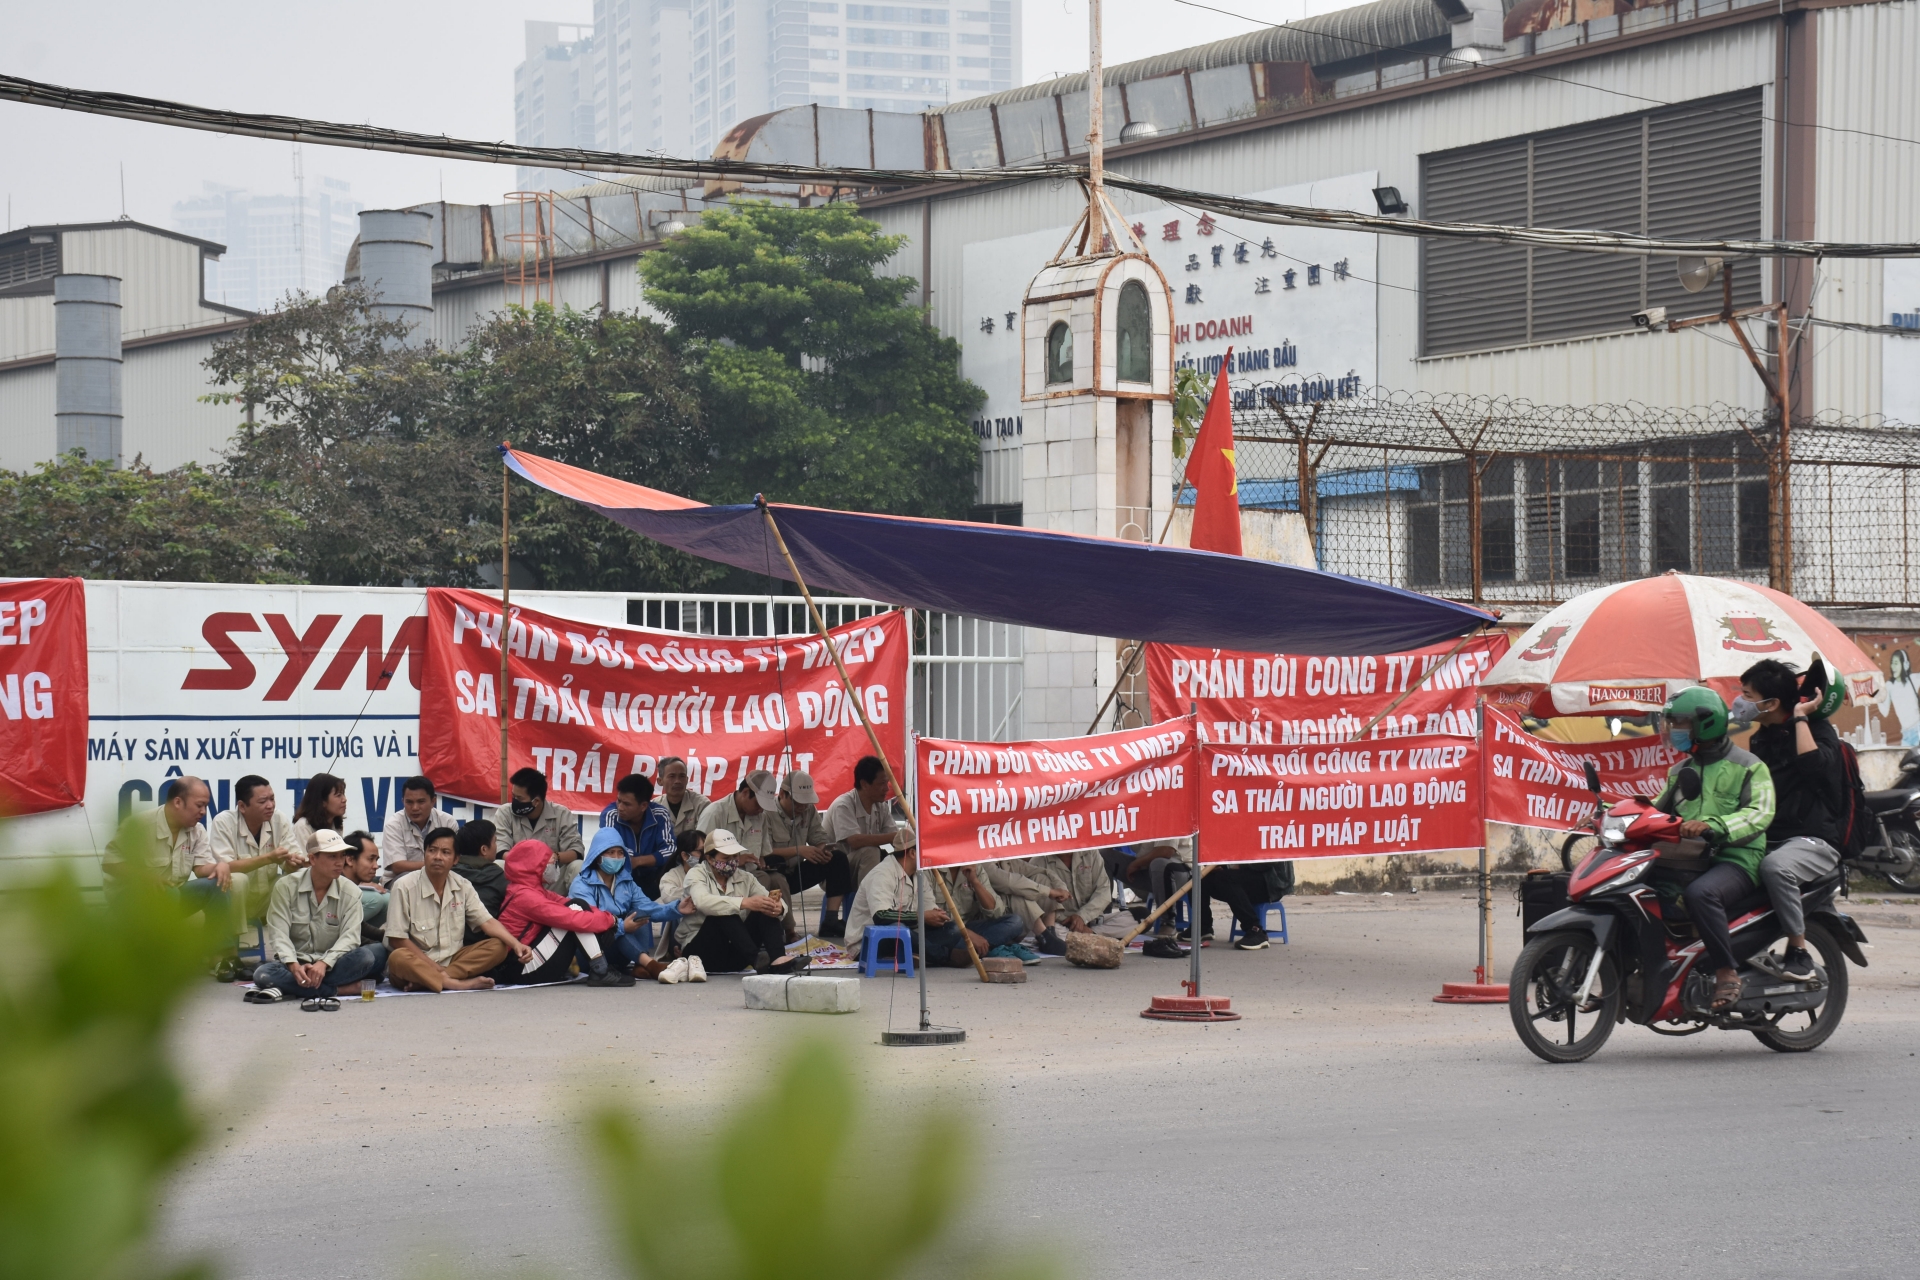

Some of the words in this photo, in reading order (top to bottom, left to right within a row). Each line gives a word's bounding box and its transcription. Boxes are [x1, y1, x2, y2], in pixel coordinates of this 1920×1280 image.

[1195, 315, 1253, 342] DOANH
[1238, 346, 1269, 373] HÀNG
[995, 417, 1014, 441] TẠO
[453, 603, 559, 662] PHẢN
[637, 640, 744, 673] CÔNG
[743, 646, 787, 672] TY
[793, 625, 885, 670] VMEP
[181, 612, 431, 702] SYM
[1172, 648, 1245, 698] PHẢN
[1385, 655, 1414, 693] TY
[1421, 651, 1490, 692] VMEP
[455, 670, 497, 717] SA
[513, 673, 595, 727] THẢI
[601, 685, 716, 734] NGƯỜI
[723, 692, 790, 733] LAO
[796, 680, 889, 737] ĐỘNG
[1591, 688, 1630, 703] HANOI
[1633, 686, 1663, 703] BEER
[88, 737, 137, 762] MÁY
[144, 728, 189, 762] SẢN
[195, 728, 254, 761] XUẤT
[261, 737, 302, 763] PHỤ
[308, 730, 363, 759] TÙNG
[373, 731, 402, 758] VÀ
[407, 737, 419, 758] L
[929, 745, 990, 775] PHẢN
[1032, 747, 1093, 773] CÔNG
[1091, 746, 1122, 767] TY
[1121, 730, 1186, 762] VMEP
[1211, 748, 1272, 777] PHẢN
[1273, 746, 1309, 776] ĐỐI
[1314, 748, 1371, 774] CÔNG
[1378, 749, 1403, 772] TY
[1408, 746, 1468, 770] VMEP
[1600, 751, 1625, 771] TY
[531, 743, 619, 794] TRÁI
[1493, 754, 1514, 779] SA
[930, 789, 962, 816] SA
[967, 780, 1018, 814] THẢI
[1024, 777, 1086, 811] NGƯỜI
[1125, 764, 1184, 797] ĐỘNG
[1212, 789, 1238, 814] SA
[1245, 781, 1294, 813] THẢI
[1299, 780, 1364, 811] NGƯỜI
[1369, 782, 1407, 808] LAO
[1413, 777, 1466, 810] ĐỘNG
[1527, 793, 1565, 821] TRÁI
[977, 816, 1023, 849] TRÁI
[1028, 810, 1084, 844] PHÁP
[1089, 803, 1140, 838] LUẬT
[1258, 820, 1305, 849] TRÁI
[1312, 817, 1368, 847] PHÁP
[1373, 814, 1422, 847] LUẬT
